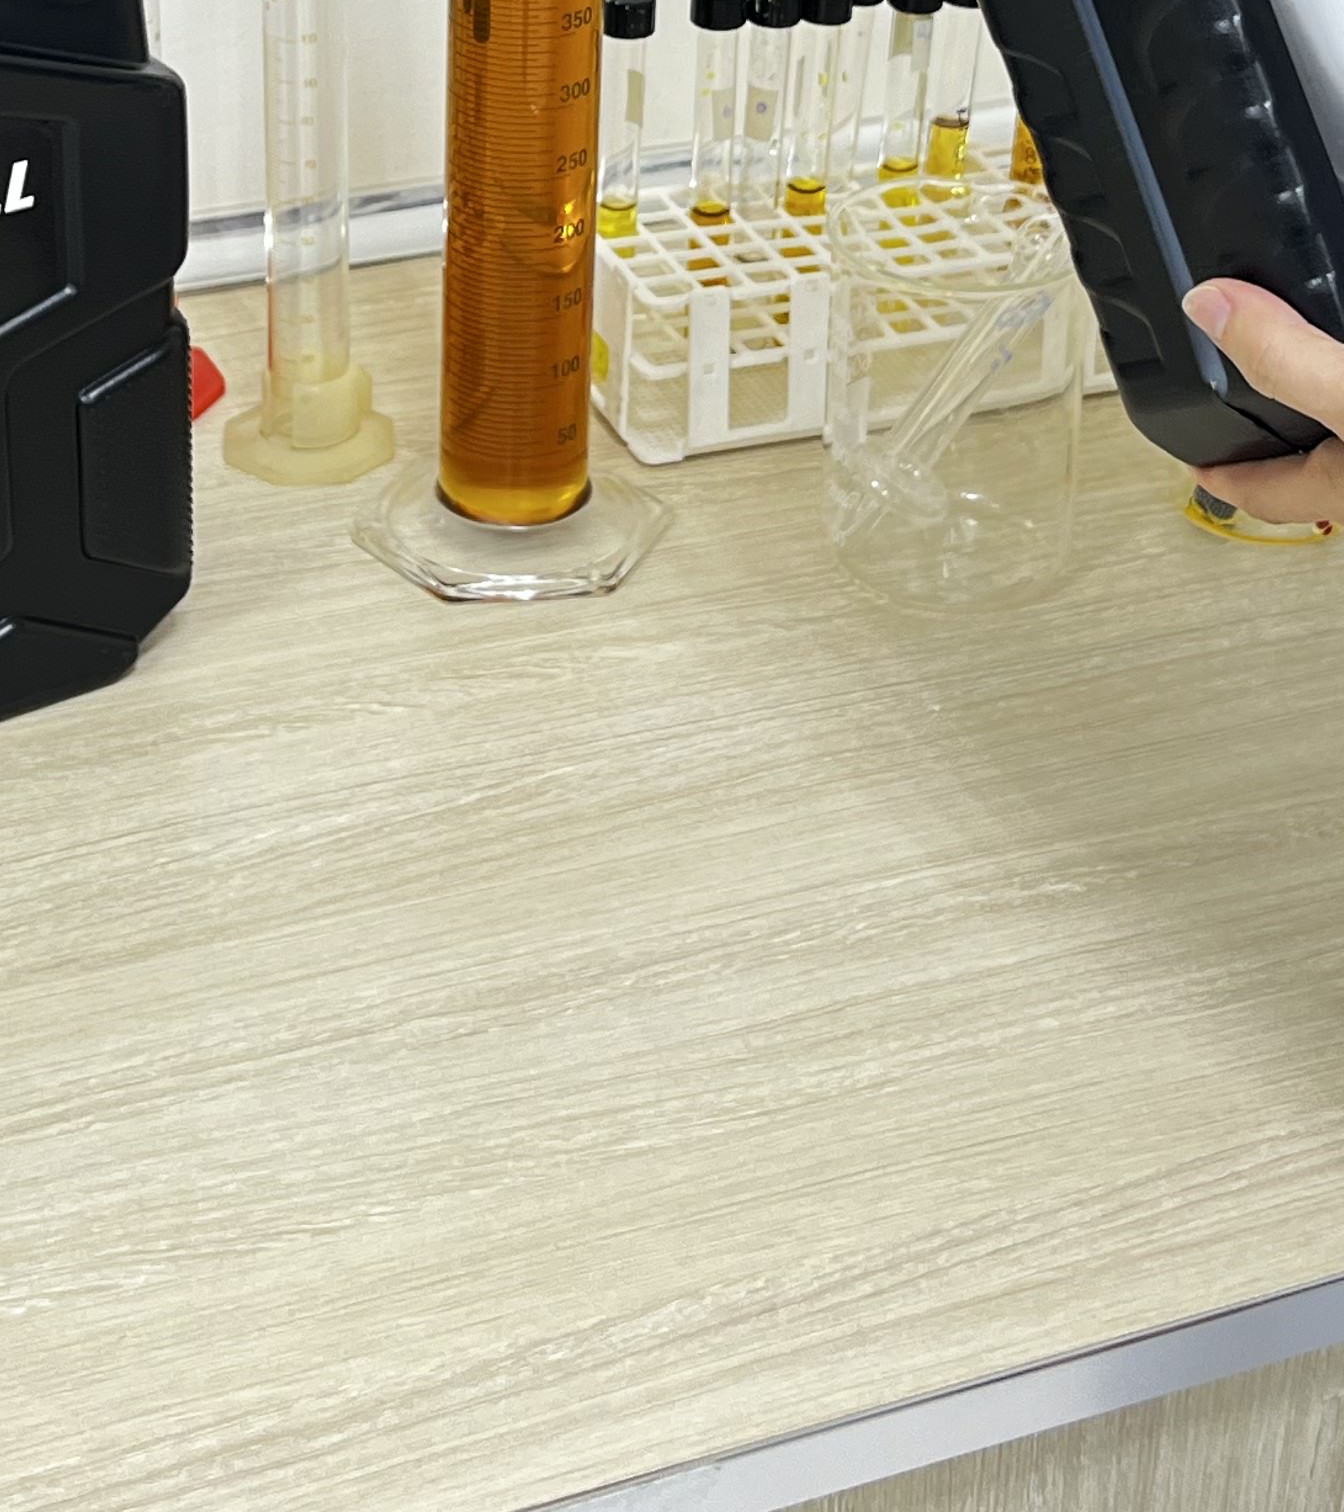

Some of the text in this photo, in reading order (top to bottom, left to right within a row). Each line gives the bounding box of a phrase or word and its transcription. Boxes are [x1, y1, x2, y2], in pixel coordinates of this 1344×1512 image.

[561, 7, 592, 32] 350
[560, 78, 591, 103] 300
[557, 149, 588, 173] 250
[553, 218, 585, 244] 200
[553, 288, 582, 313] 150
[552, 355, 580, 379] 100
